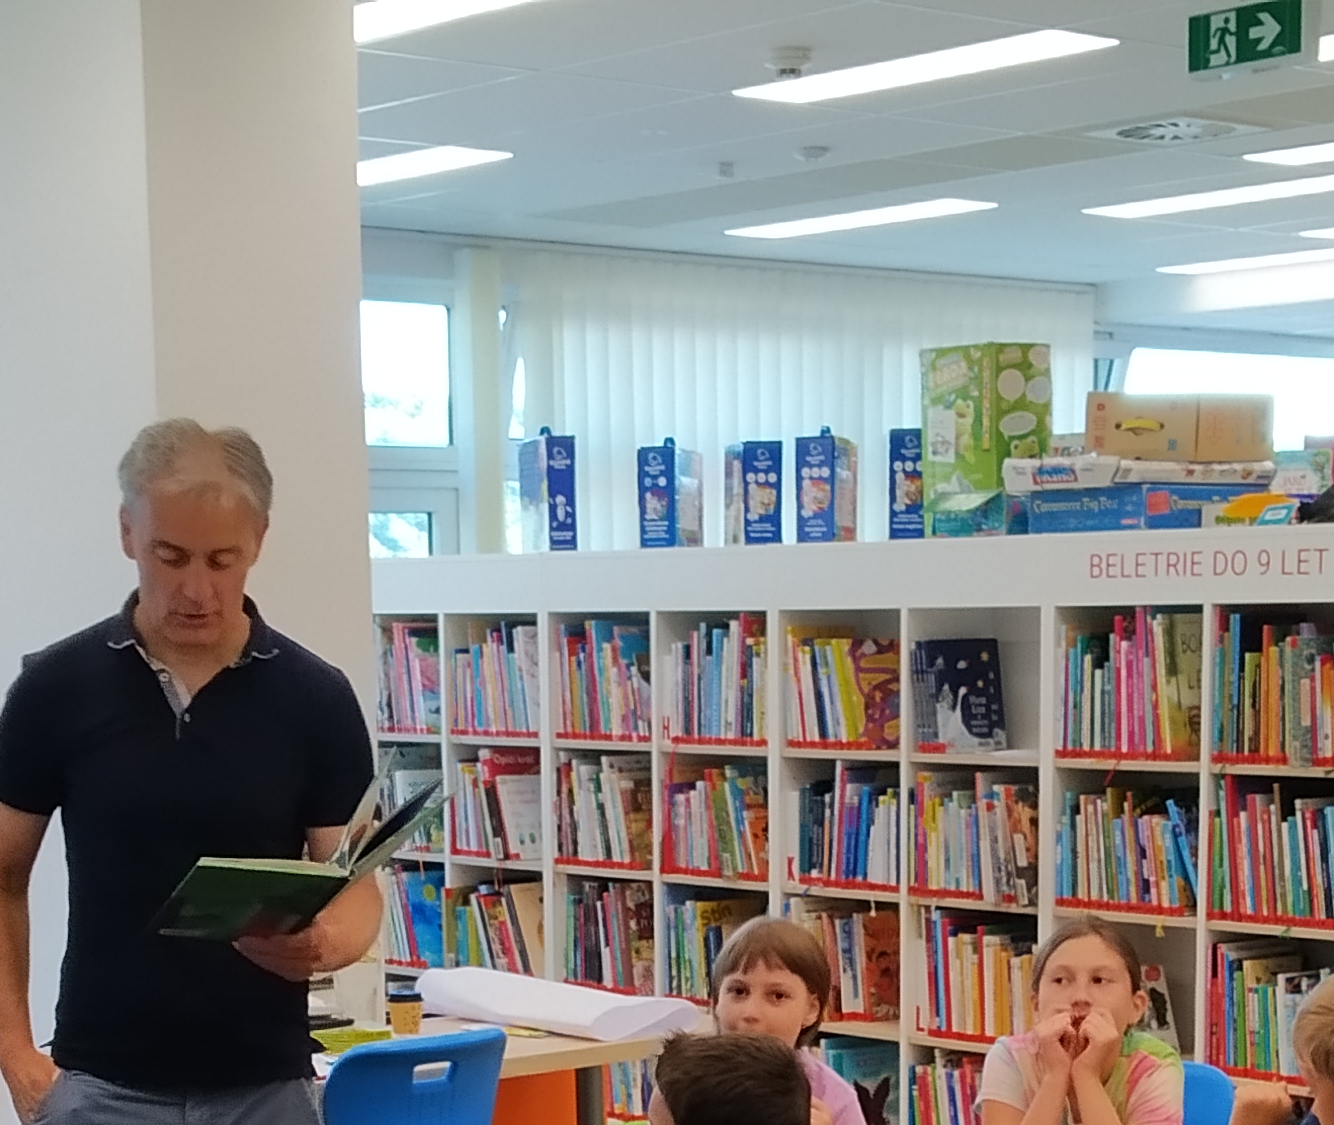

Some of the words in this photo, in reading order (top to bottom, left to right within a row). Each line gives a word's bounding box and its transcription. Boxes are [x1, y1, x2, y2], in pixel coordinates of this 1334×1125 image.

[1089, 551, 1204, 579] BELETRIE
[1212, 550, 1249, 577] DO
[1257, 549, 1271, 577] 9
[1280, 548, 1331, 576] LET
[661, 715, 670, 740] H
[787, 856, 796, 882] K
[915, 1004, 926, 1032] L
